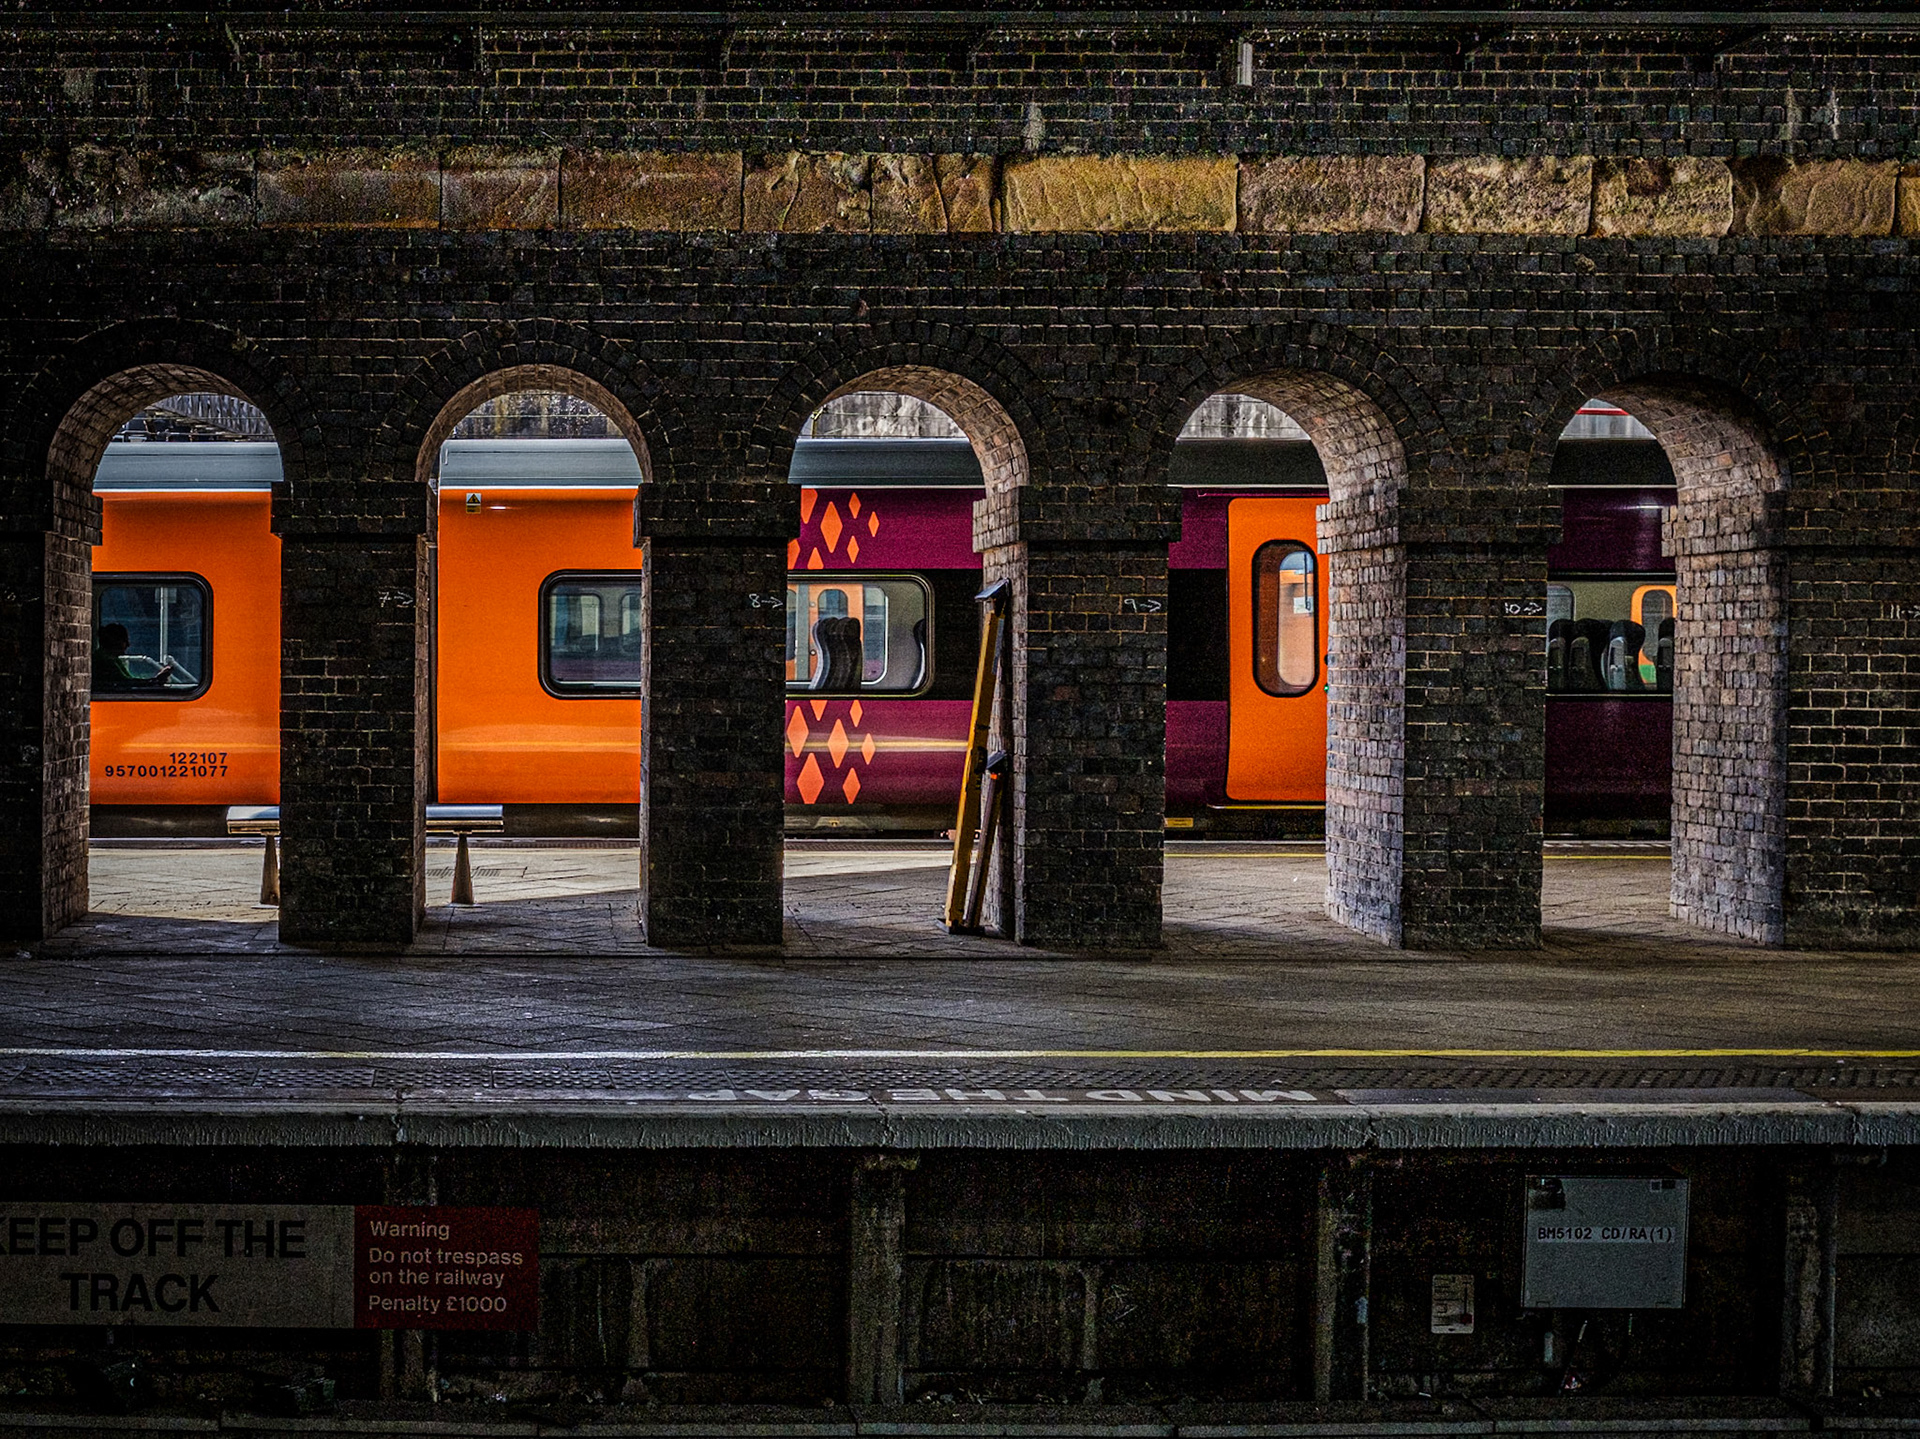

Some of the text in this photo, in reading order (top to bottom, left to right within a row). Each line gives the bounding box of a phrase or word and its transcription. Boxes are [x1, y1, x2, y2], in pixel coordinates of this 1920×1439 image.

[749, 593, 761, 609] 8
[1124, 598, 1138, 613] 9
[1504, 601, 1521, 615] 10
[170, 752, 228, 764] 122107
[105, 765, 228, 777] 957001221077
[687, 1088, 1318, 1102] MIND THE GAP
[0, 1218, 306, 1258] EEP OFF THE
[369, 1220, 450, 1241] Warning
[1538, 1227, 1672, 1243] BM5102 CD/RA(1)
[369, 1248, 524, 1268] Do not trespass
[369, 1269, 505, 1289] on the railway
[60, 1273, 220, 1312] TRACK
[368, 1295, 507, 1314] Penalty £1000
